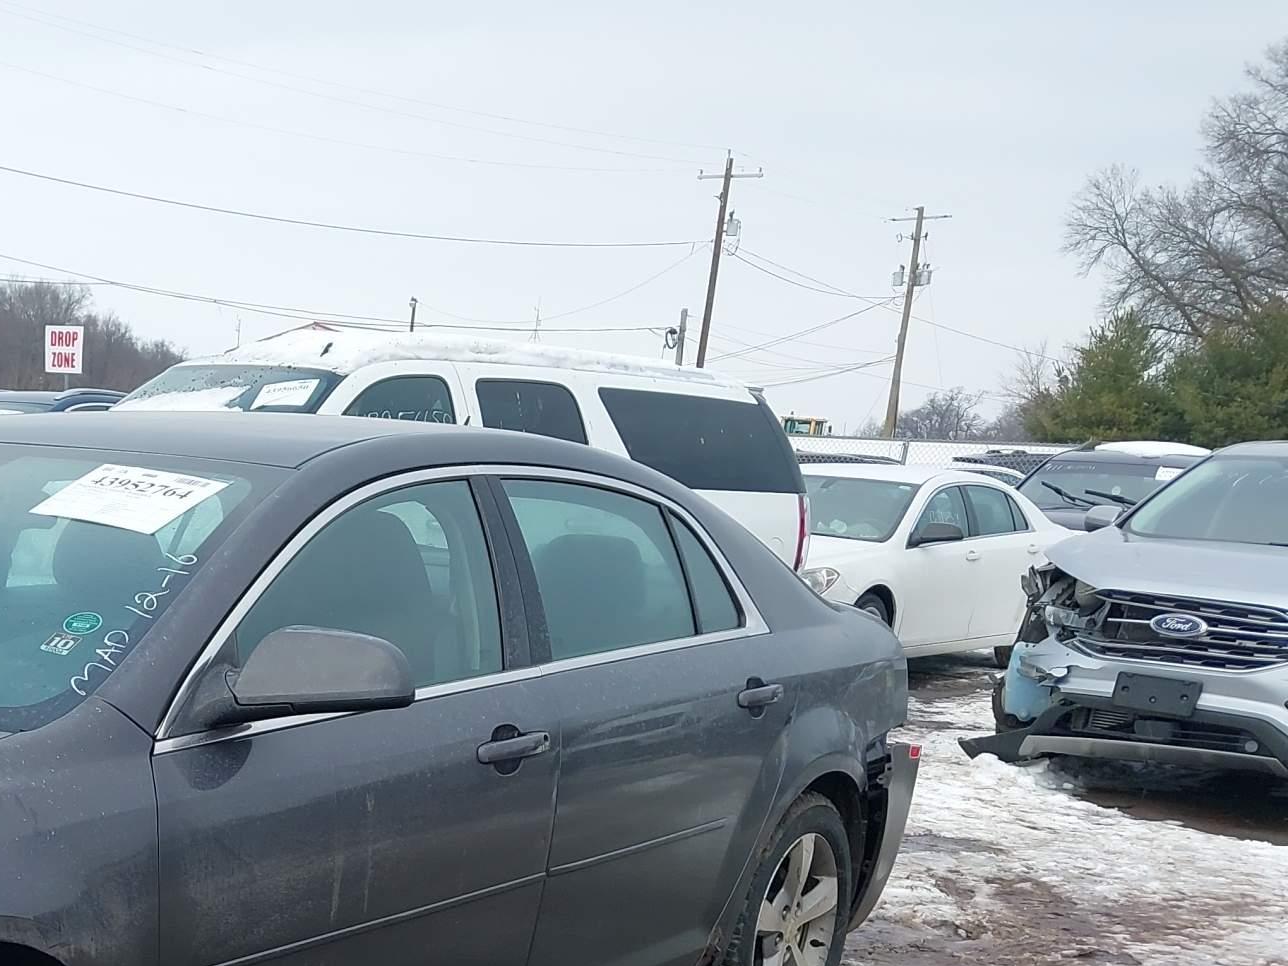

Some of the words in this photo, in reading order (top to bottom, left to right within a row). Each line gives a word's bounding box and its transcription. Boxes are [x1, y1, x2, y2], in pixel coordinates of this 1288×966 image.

[50, 330, 79, 347] DROP
[52, 351, 76, 369] ZONE
[91, 476, 195, 499] 43952764
[70, 629, 130, 696] MAD
[124, 552, 198, 618] 12-16
[1161, 617, 1192, 632] Ford
